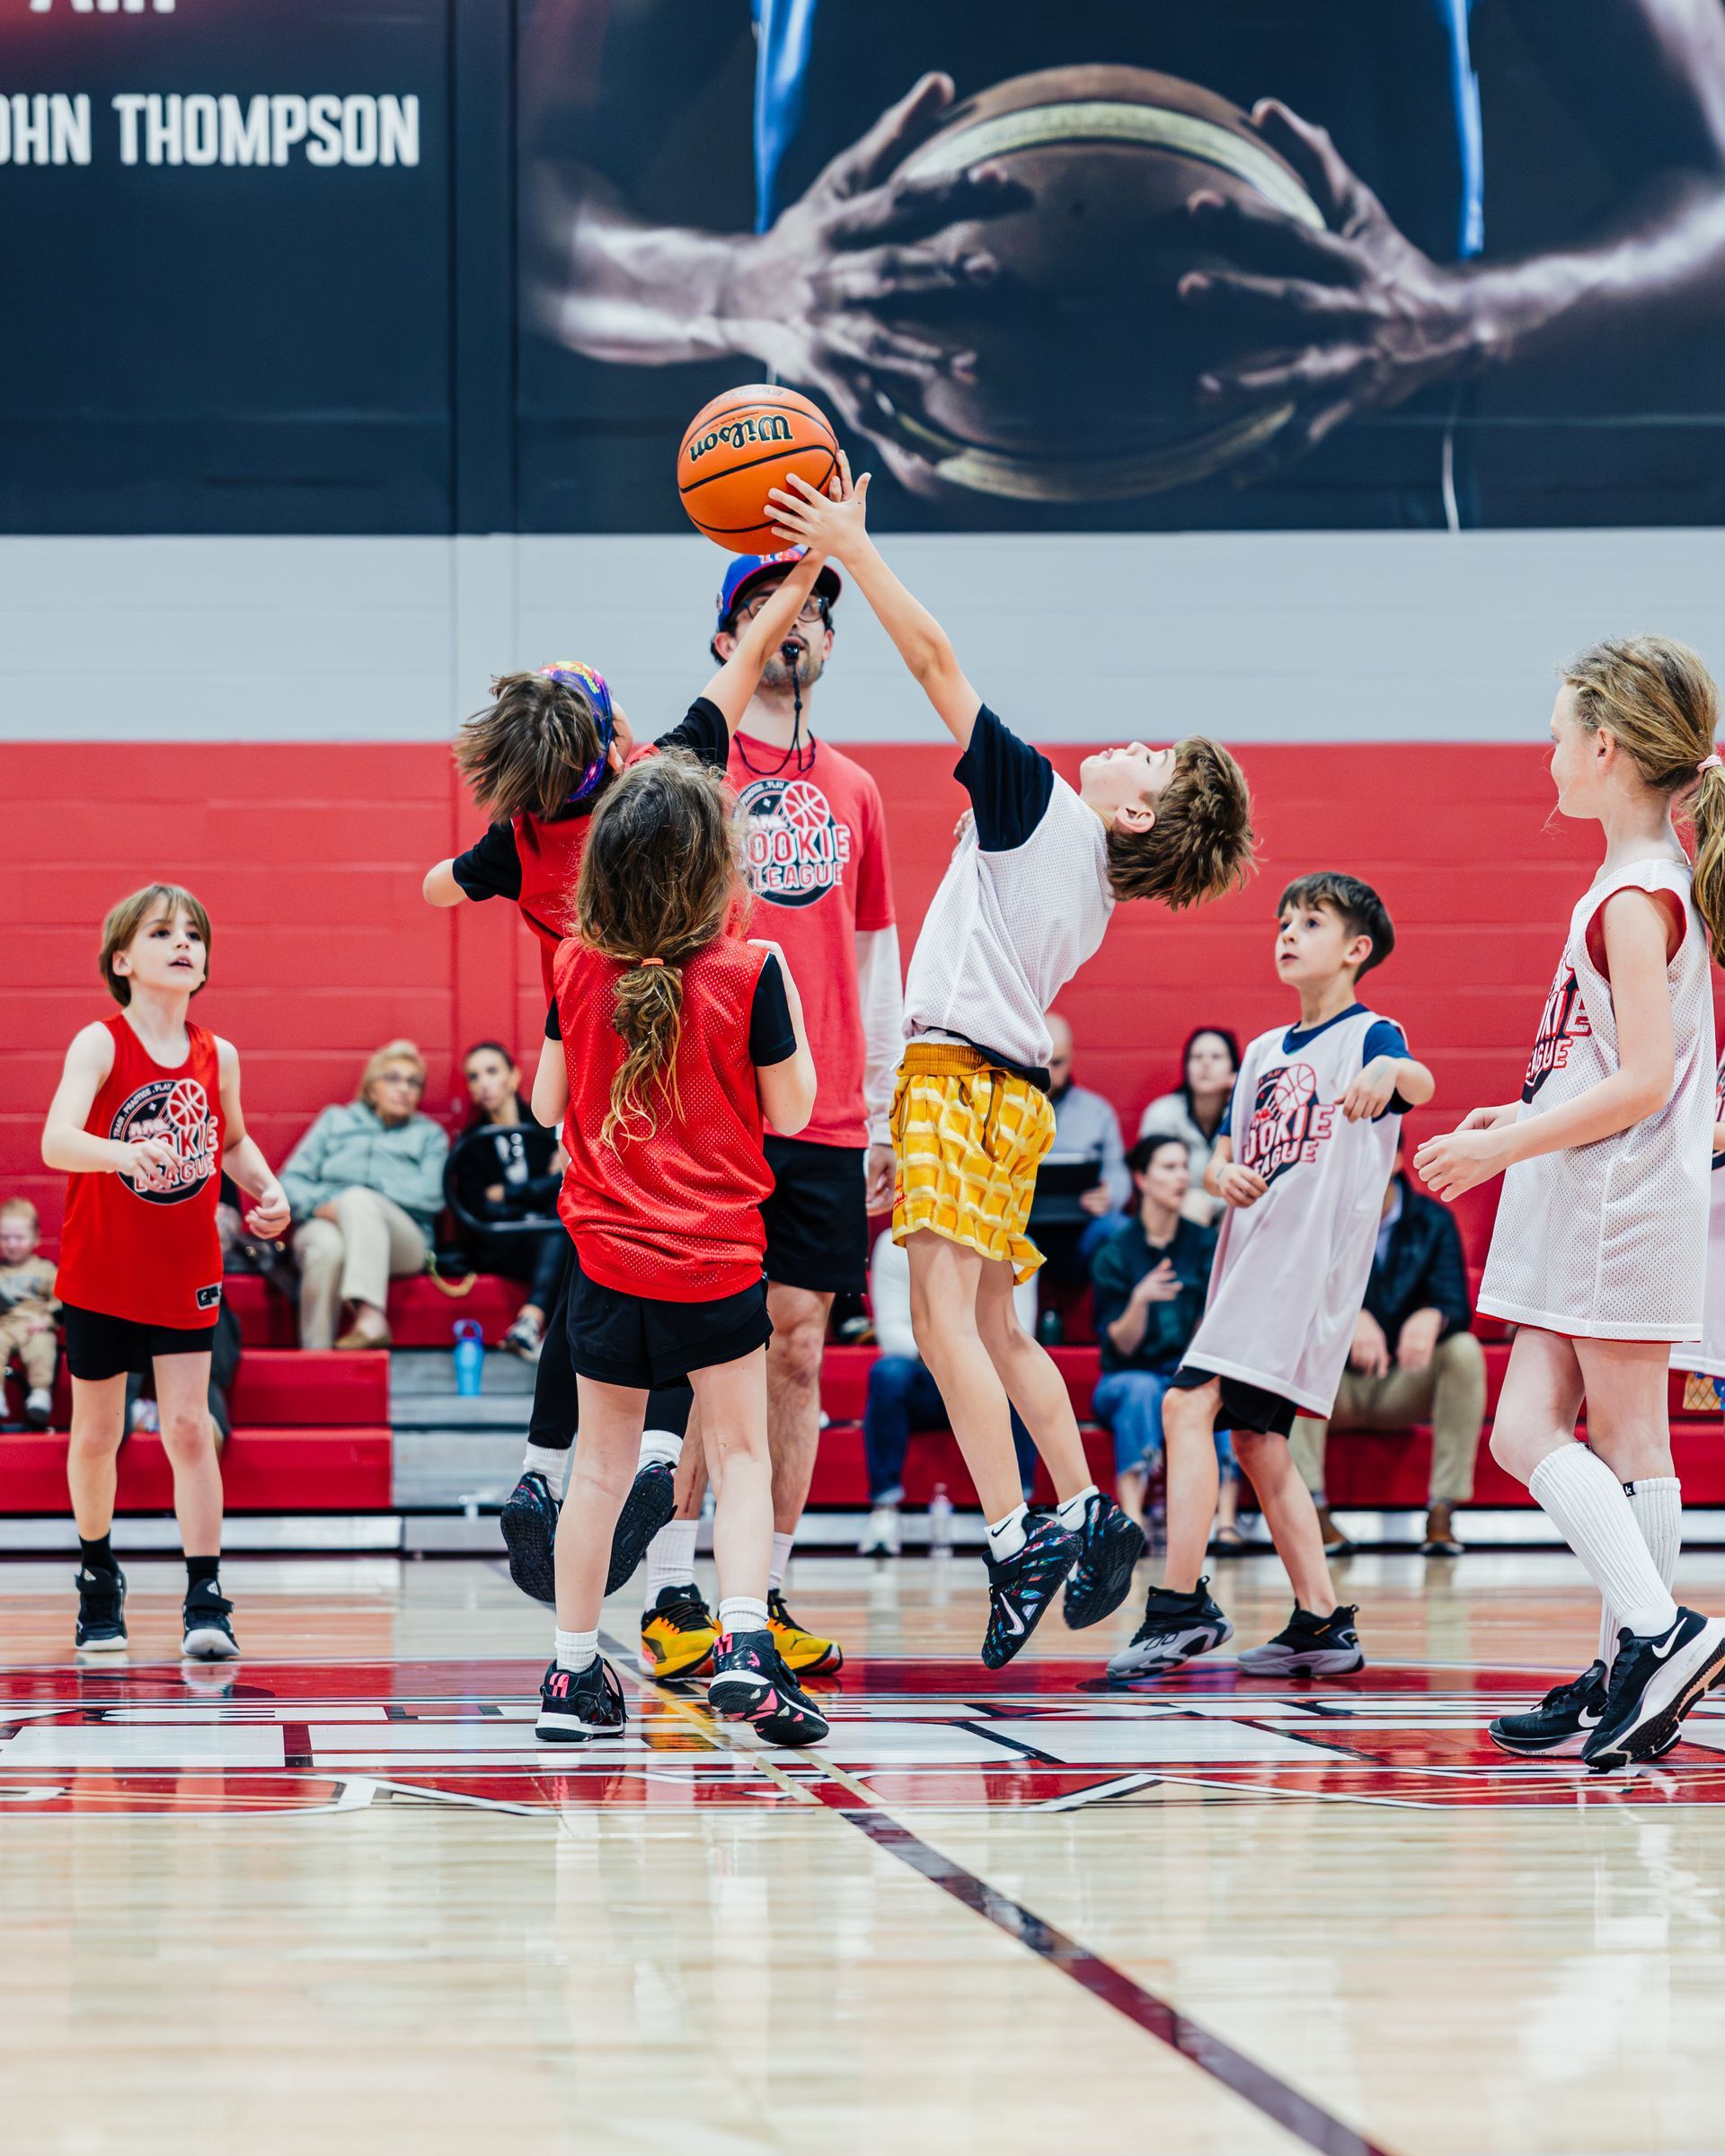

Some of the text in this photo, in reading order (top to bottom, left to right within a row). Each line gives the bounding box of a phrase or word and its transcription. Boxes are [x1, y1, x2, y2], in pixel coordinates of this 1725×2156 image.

[0, 93, 420, 166] HN THOMPSON
[689, 414, 794, 463] Wilson
[739, 824, 851, 868] OOKIE
[754, 862, 845, 891] LEAGUE
[154, 1082, 172, 1093] PLAY
[134, 1153, 217, 1193] LAGUE
